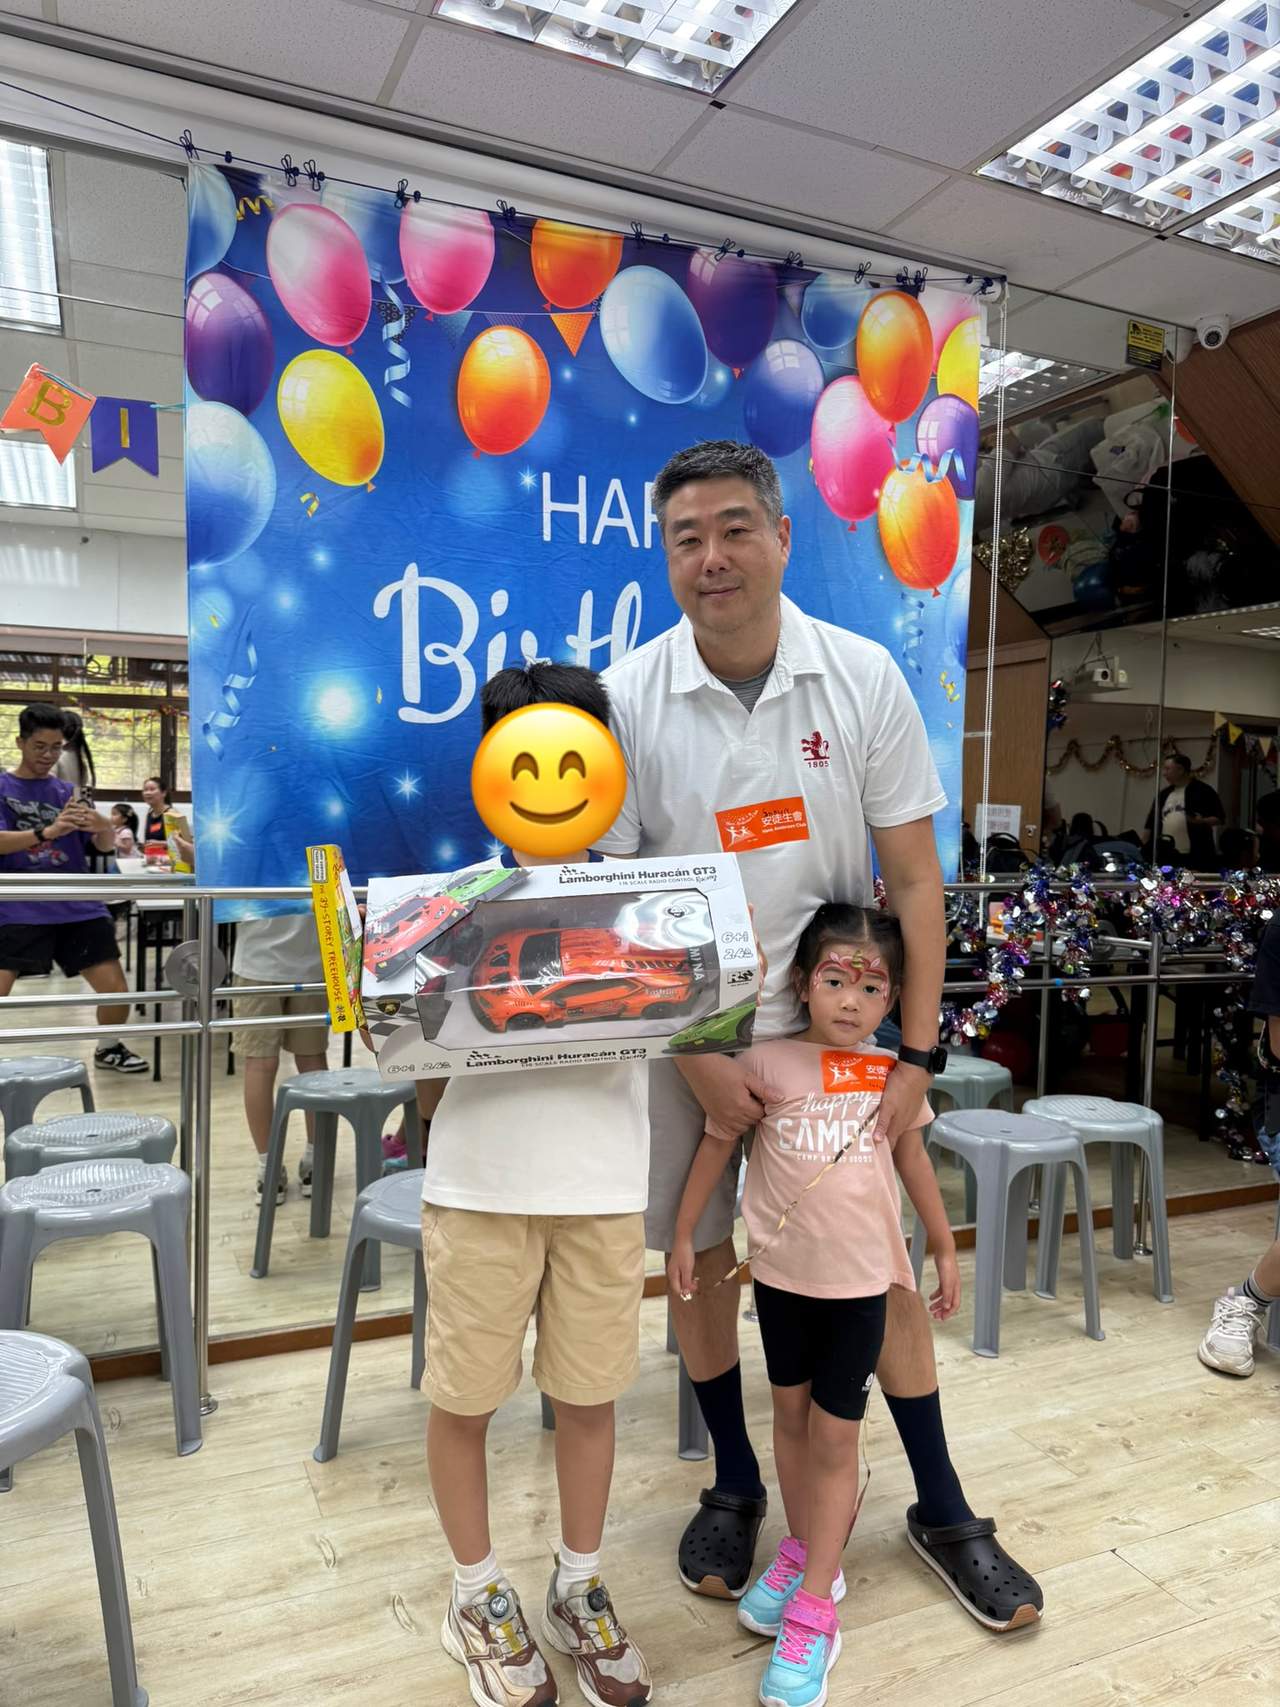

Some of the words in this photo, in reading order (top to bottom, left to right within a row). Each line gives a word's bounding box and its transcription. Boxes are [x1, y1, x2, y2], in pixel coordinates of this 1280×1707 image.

[807, 760, 830, 768] 1805
[559, 870, 635, 884] Lamborghini
[638, 868, 690, 880] Huracán
[693, 866, 717, 876] GT3
[319, 896, 335, 946] 39-STOREY
[327, 951, 343, 1002] TREEHOUSE
[466, 1054, 554, 1068] Lamborghini
[557, 1050, 616, 1060] Huracán
[801, 1091, 873, 1122] happy
[796, 1153, 818, 1161] CAMP
